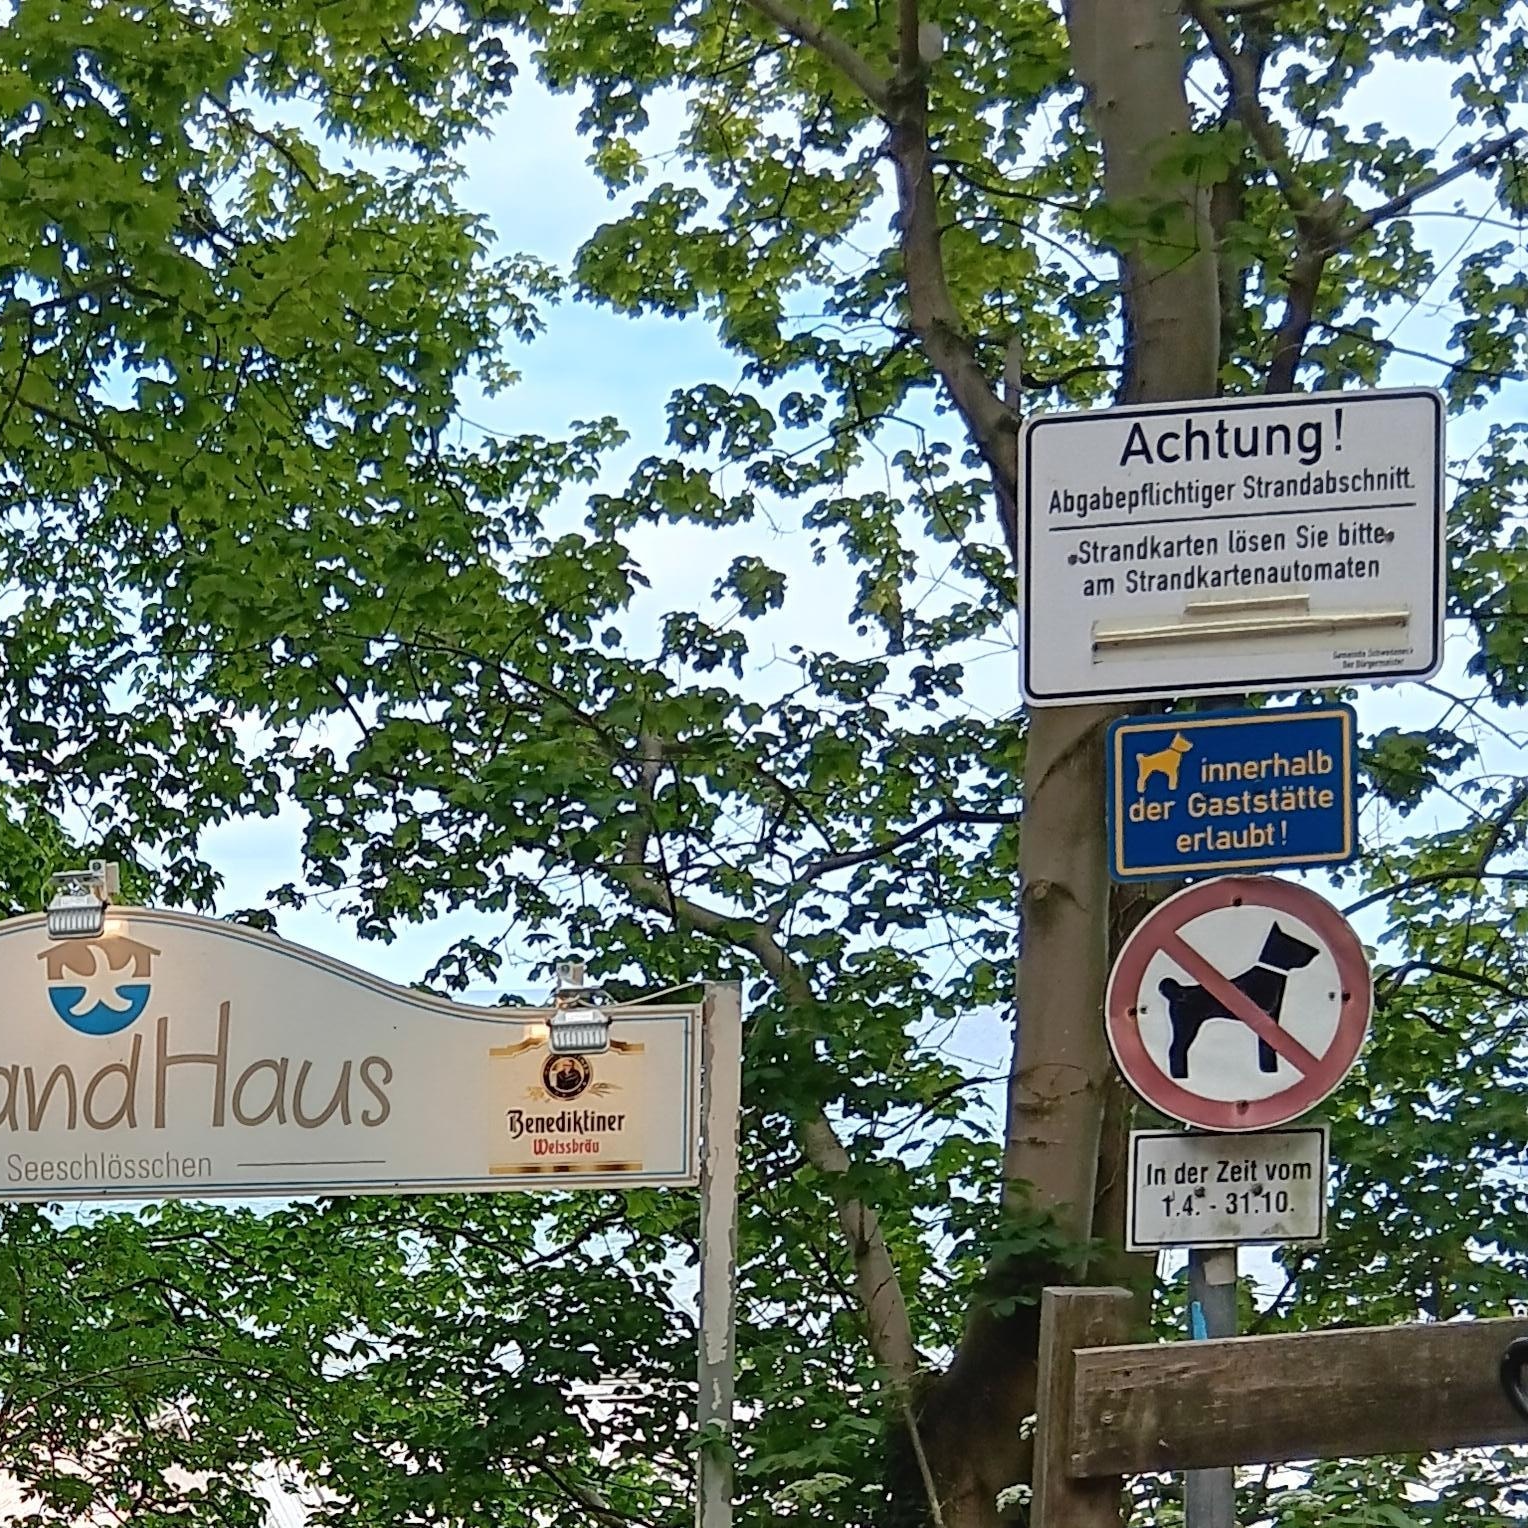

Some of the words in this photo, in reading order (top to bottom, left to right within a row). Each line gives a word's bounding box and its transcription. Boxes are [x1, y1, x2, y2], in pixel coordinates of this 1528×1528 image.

[1120, 408, 1343, 466] Achtung!
[1049, 479, 1236, 518] Abgabepflichtiger
[1078, 533, 1218, 564] Strandkarten
[1228, 530, 1285, 554] lösen
[1296, 524, 1329, 549] Sie
[1338, 522, 1386, 547] bitte
[1083, 577, 1114, 597] am
[1126, 556, 1380, 593] Strandkartenautomaten
[1201, 749, 1333, 784] innerhalb
[1129, 797, 1176, 822] der
[1188, 785, 1334, 818] Gaststätte
[1176, 820, 1288, 853] erlaubt!
[507, 1110, 625, 1139] Benediktiner
[533, 1139, 600, 1155] Weissbräu
[6, 1153, 212, 1182] Seeschlösschen
[1147, 1163, 1166, 1185] In
[1174, 1162, 1208, 1184] der
[1216, 1160, 1257, 1183] Zeit
[1265, 1162, 1311, 1181] vom
[1162, 1192, 1200, 1217] 1.4.
[1225, 1191, 1296, 1215] 31.10.
